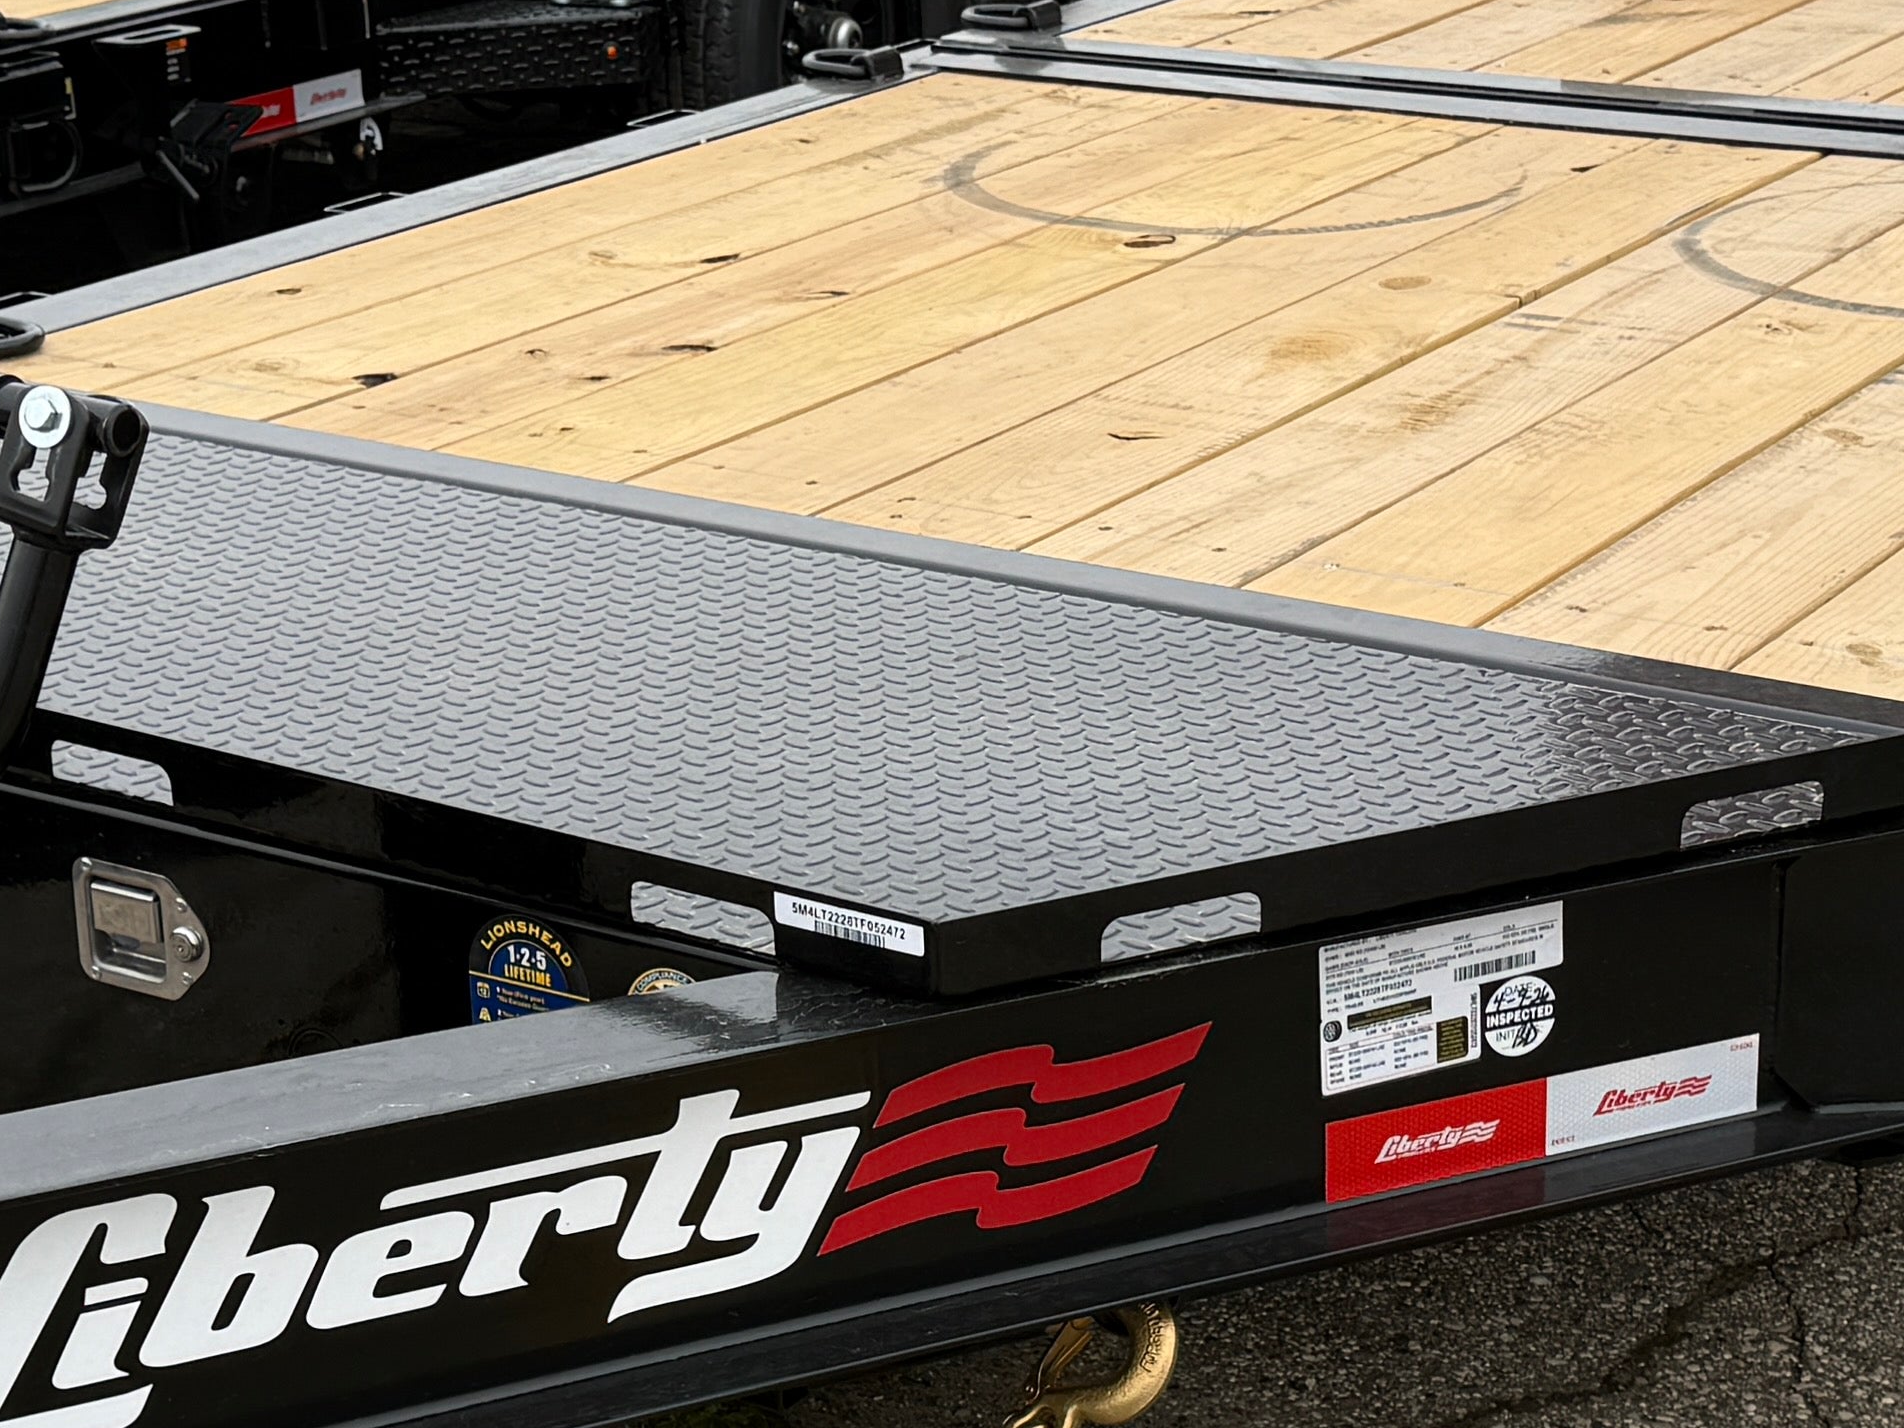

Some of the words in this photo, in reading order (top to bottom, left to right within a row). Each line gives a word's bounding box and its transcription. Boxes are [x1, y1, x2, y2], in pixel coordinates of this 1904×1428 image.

[480, 919, 573, 968] LIONSHEAD
[504, 963, 552, 987] LIFETIME
[1486, 1004, 1554, 1028] INSPECTED
[1592, 1081, 1678, 1117] Liberty
[1374, 1126, 1464, 1164] Liberty
